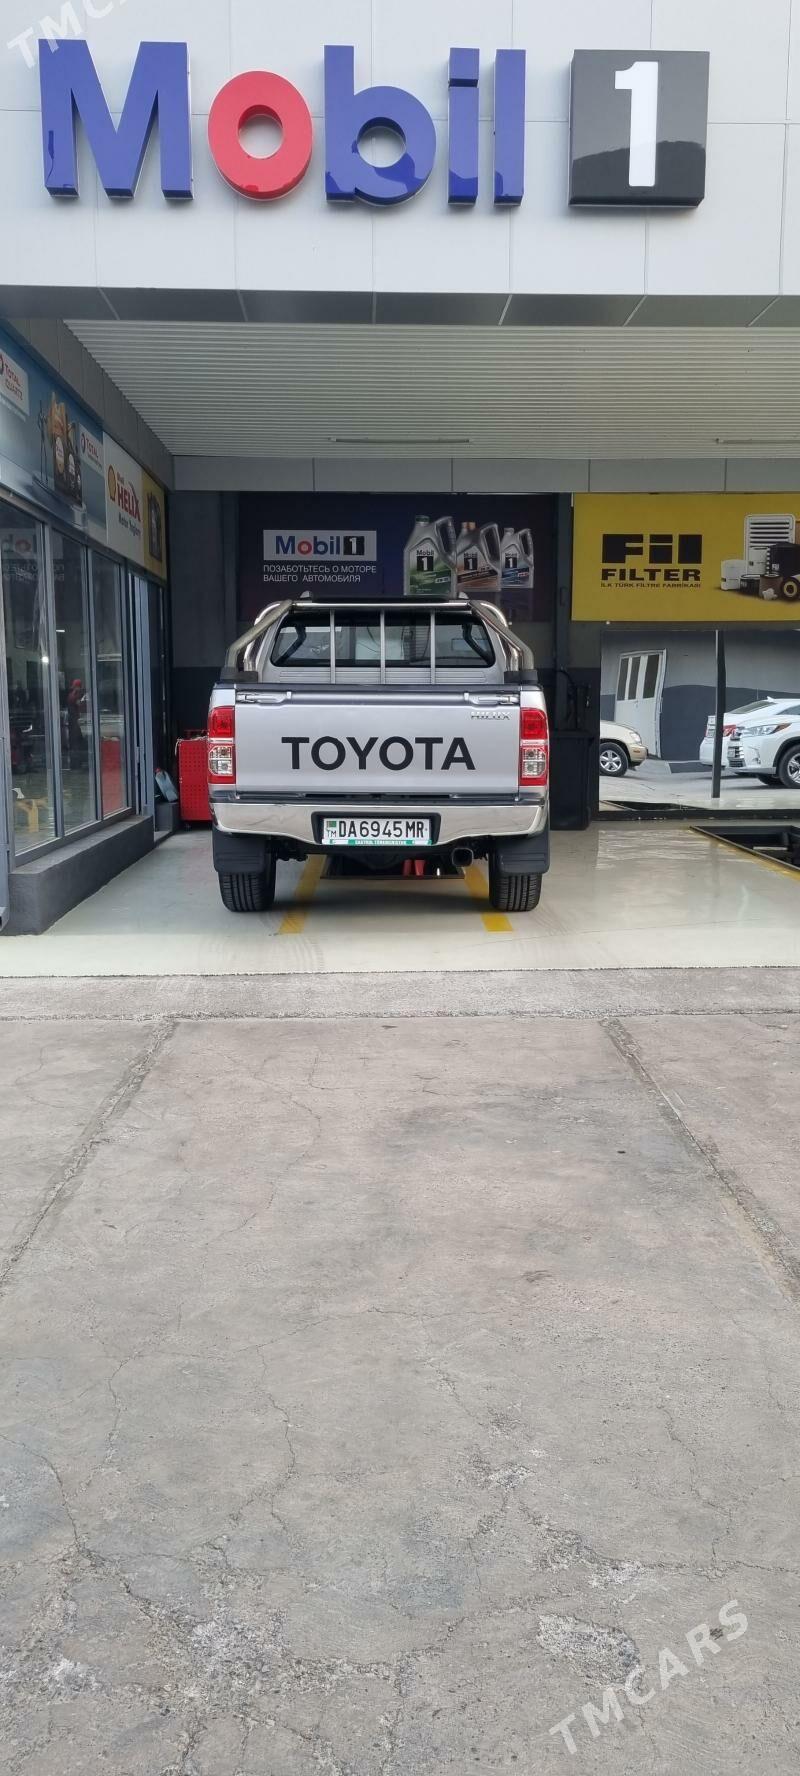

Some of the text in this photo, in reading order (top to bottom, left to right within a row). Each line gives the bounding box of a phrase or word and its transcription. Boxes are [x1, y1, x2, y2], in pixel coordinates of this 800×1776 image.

[38, 39, 660, 206] Mobil 1
[117, 482, 141, 522] HELIX
[275, 535, 358, 555] Mobil 1
[263, 564, 377, 574] ПОЗАБОТЬТЕСЬ О МОТОРЕ
[601, 568, 701, 581] FILTER
[263, 574, 361, 583] ВАШЕГО АВТОМОБИЛЯ
[281, 735, 476, 771] TOYOTA
[326, 829, 337, 838] TM
